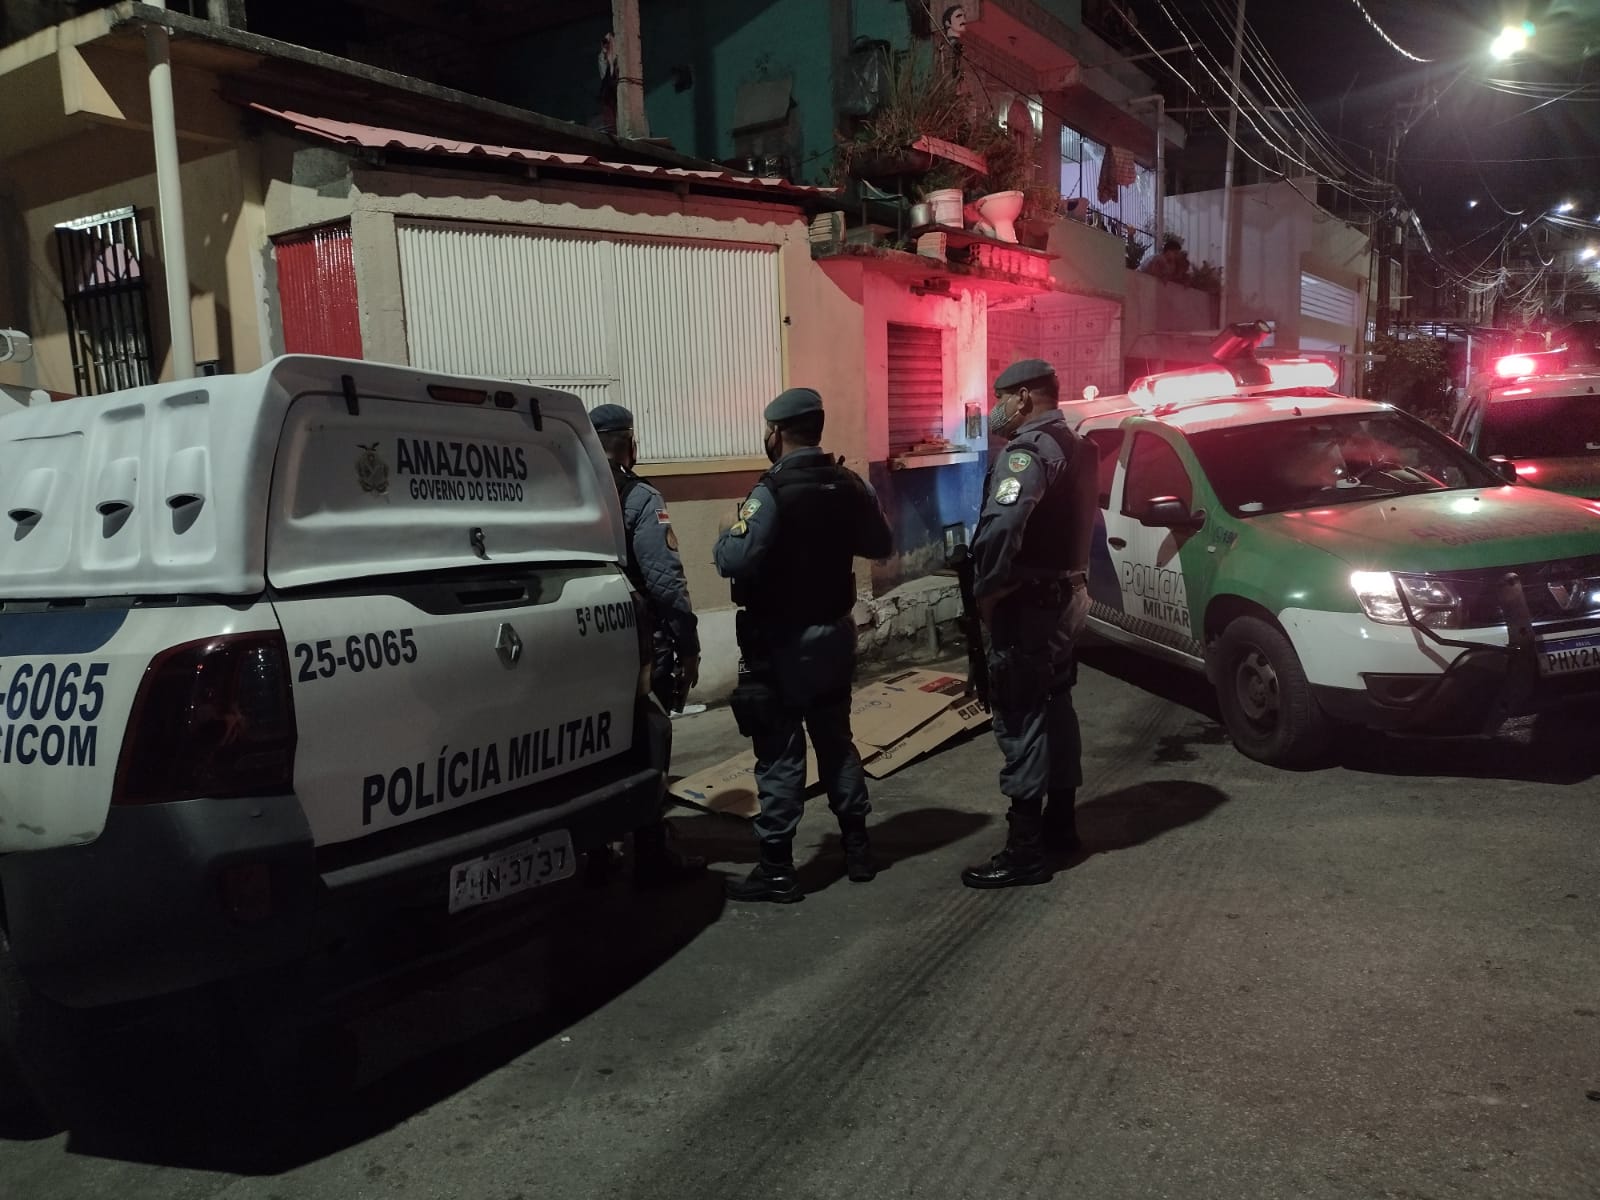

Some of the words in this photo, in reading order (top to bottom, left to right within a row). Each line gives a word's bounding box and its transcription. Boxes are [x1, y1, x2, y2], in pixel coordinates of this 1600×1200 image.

[396, 437, 528, 481] AMAZONAS
[410, 478, 466, 501] GOVERNO
[468, 481, 484, 502] DO
[487, 481, 524, 503] ESTADO
[594, 601, 636, 634] CICOM
[1143, 598, 1190, 628] MILITAR
[294, 628, 418, 682] 25-6065
[0, 662, 110, 721] -6065
[0, 723, 98, 767] ICOM
[362, 744, 502, 826] POLÍCIA
[508, 710, 612, 782] MILITAR
